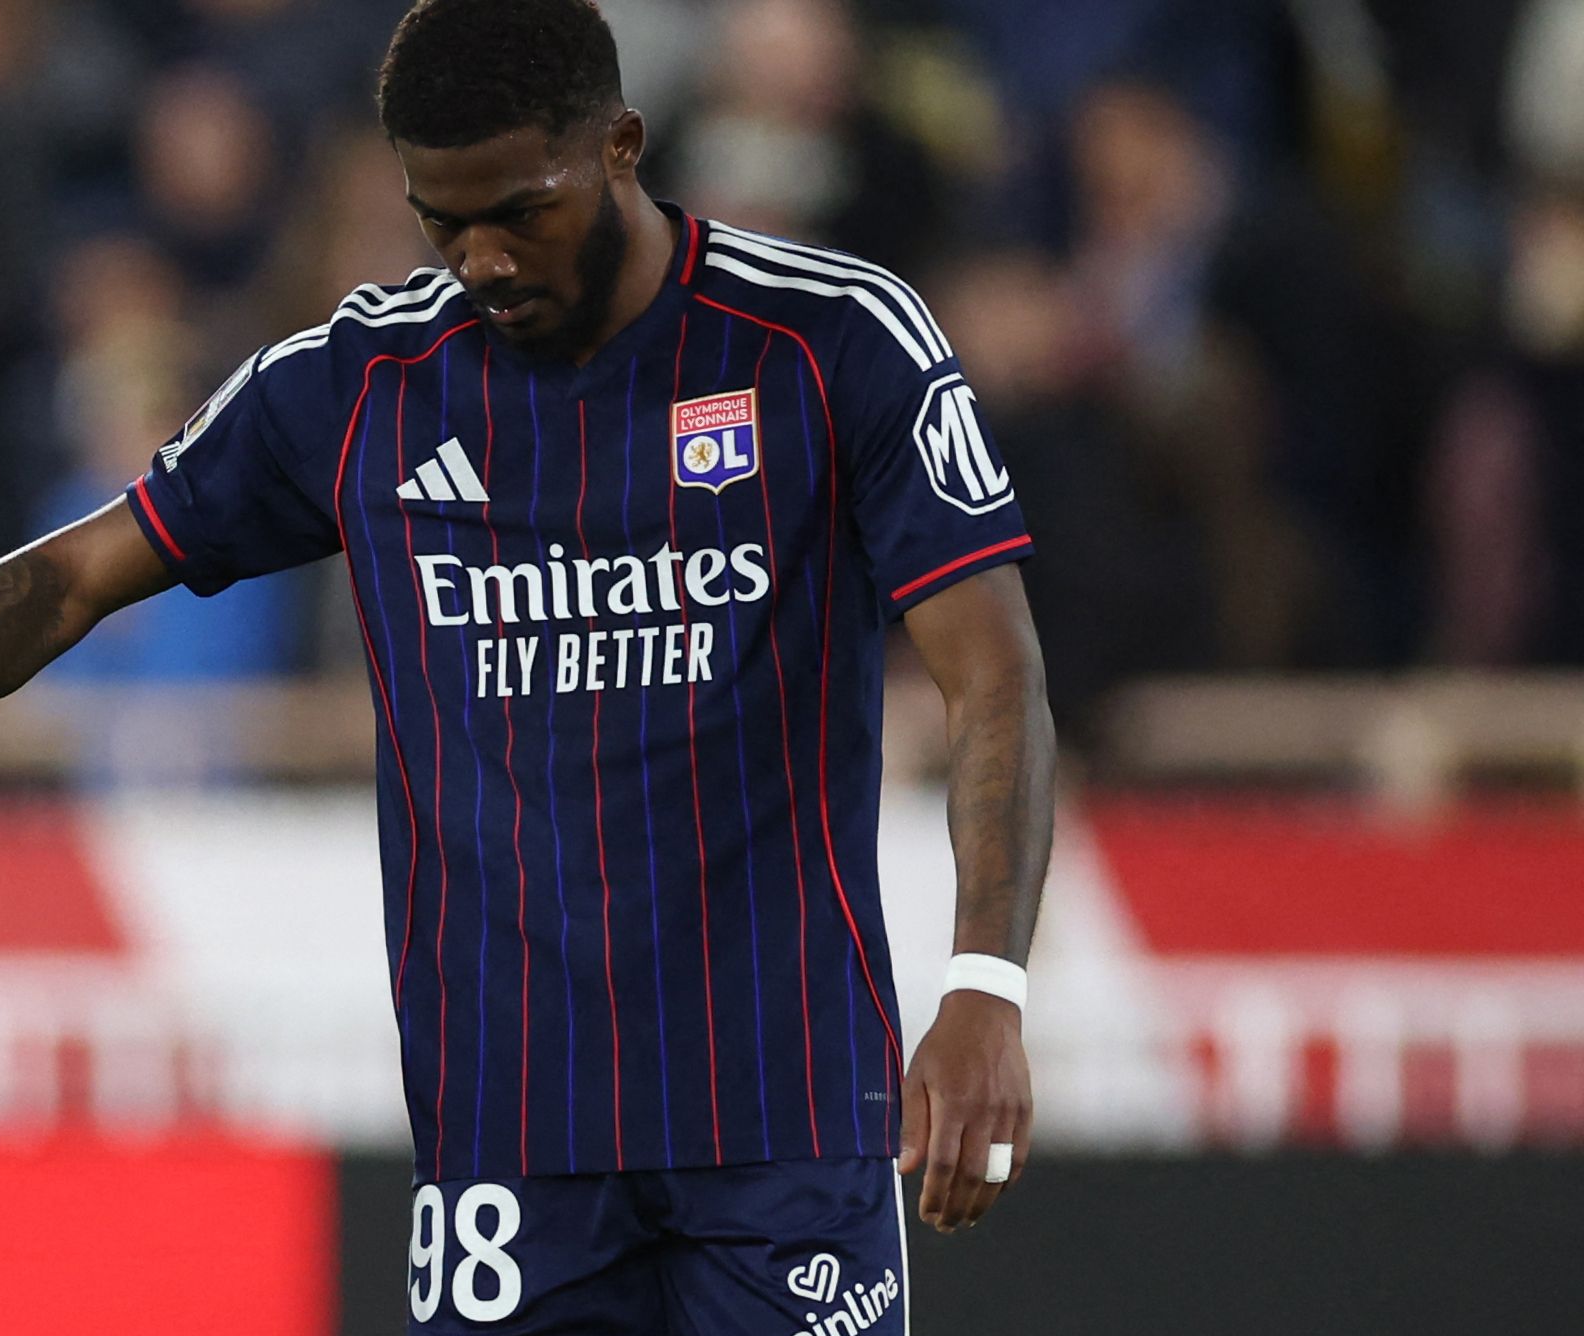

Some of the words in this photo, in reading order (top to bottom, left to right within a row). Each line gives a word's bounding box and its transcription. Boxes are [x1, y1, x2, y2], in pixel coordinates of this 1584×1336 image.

[680, 397, 748, 419] OLYMPIQUE
[680, 408, 749, 431] LYONNAIS
[414, 541, 770, 627] Emirates
[477, 636, 539, 698] FLY
[556, 622, 714, 693] BETTER
[411, 1183, 522, 1323] 98
